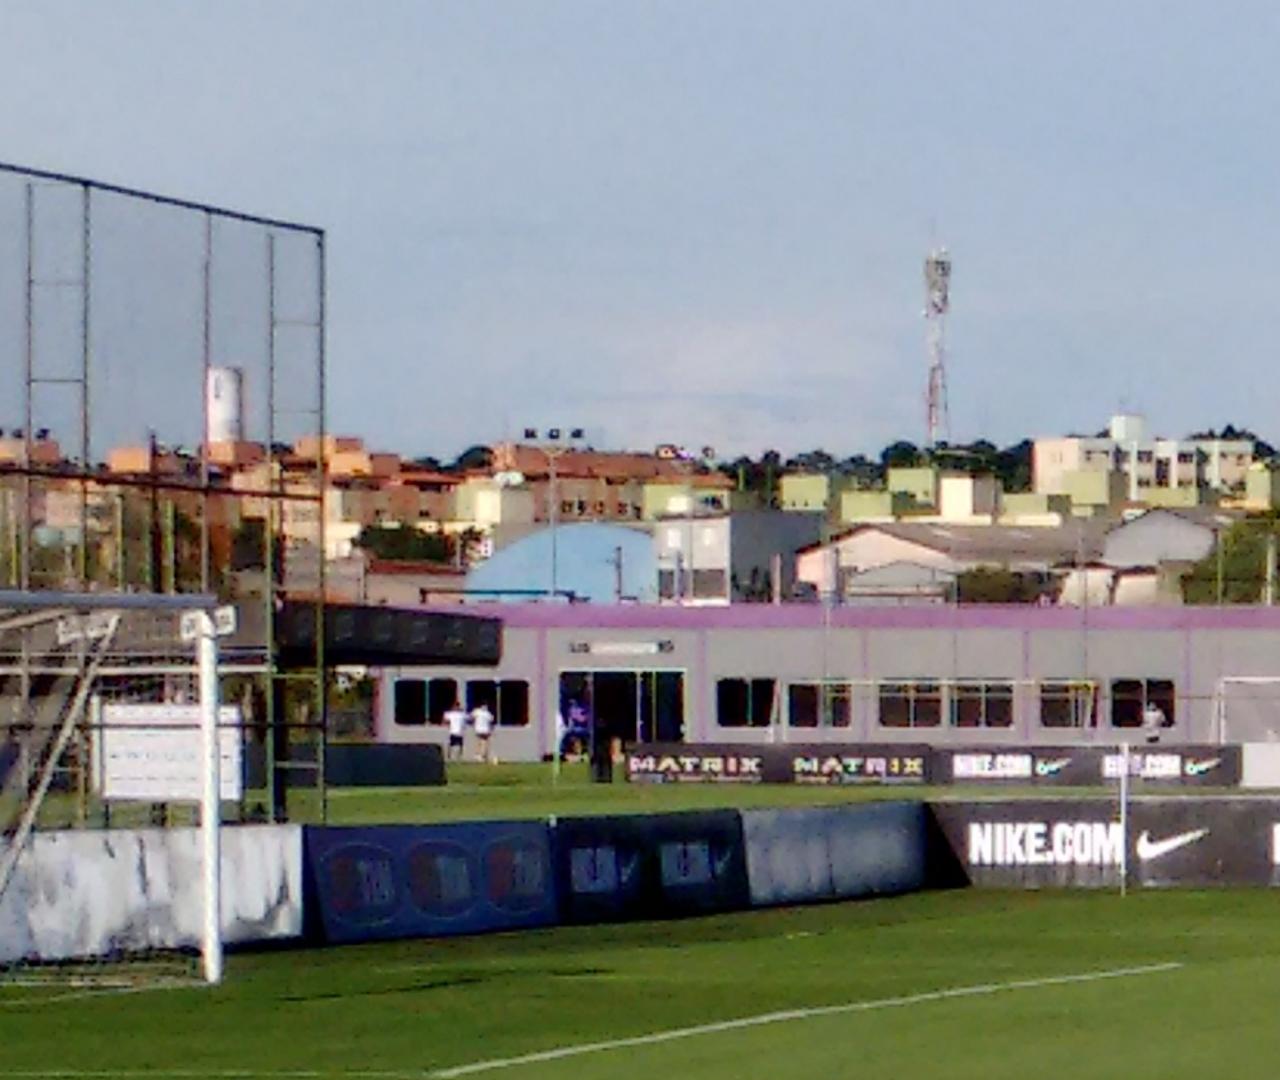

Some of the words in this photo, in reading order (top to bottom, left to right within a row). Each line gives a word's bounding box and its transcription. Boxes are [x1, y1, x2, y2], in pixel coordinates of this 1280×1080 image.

[630, 756, 763, 773] MATRIX
[794, 756, 922, 773] MATRIX
[969, 822, 1123, 864] NIKE.COM
